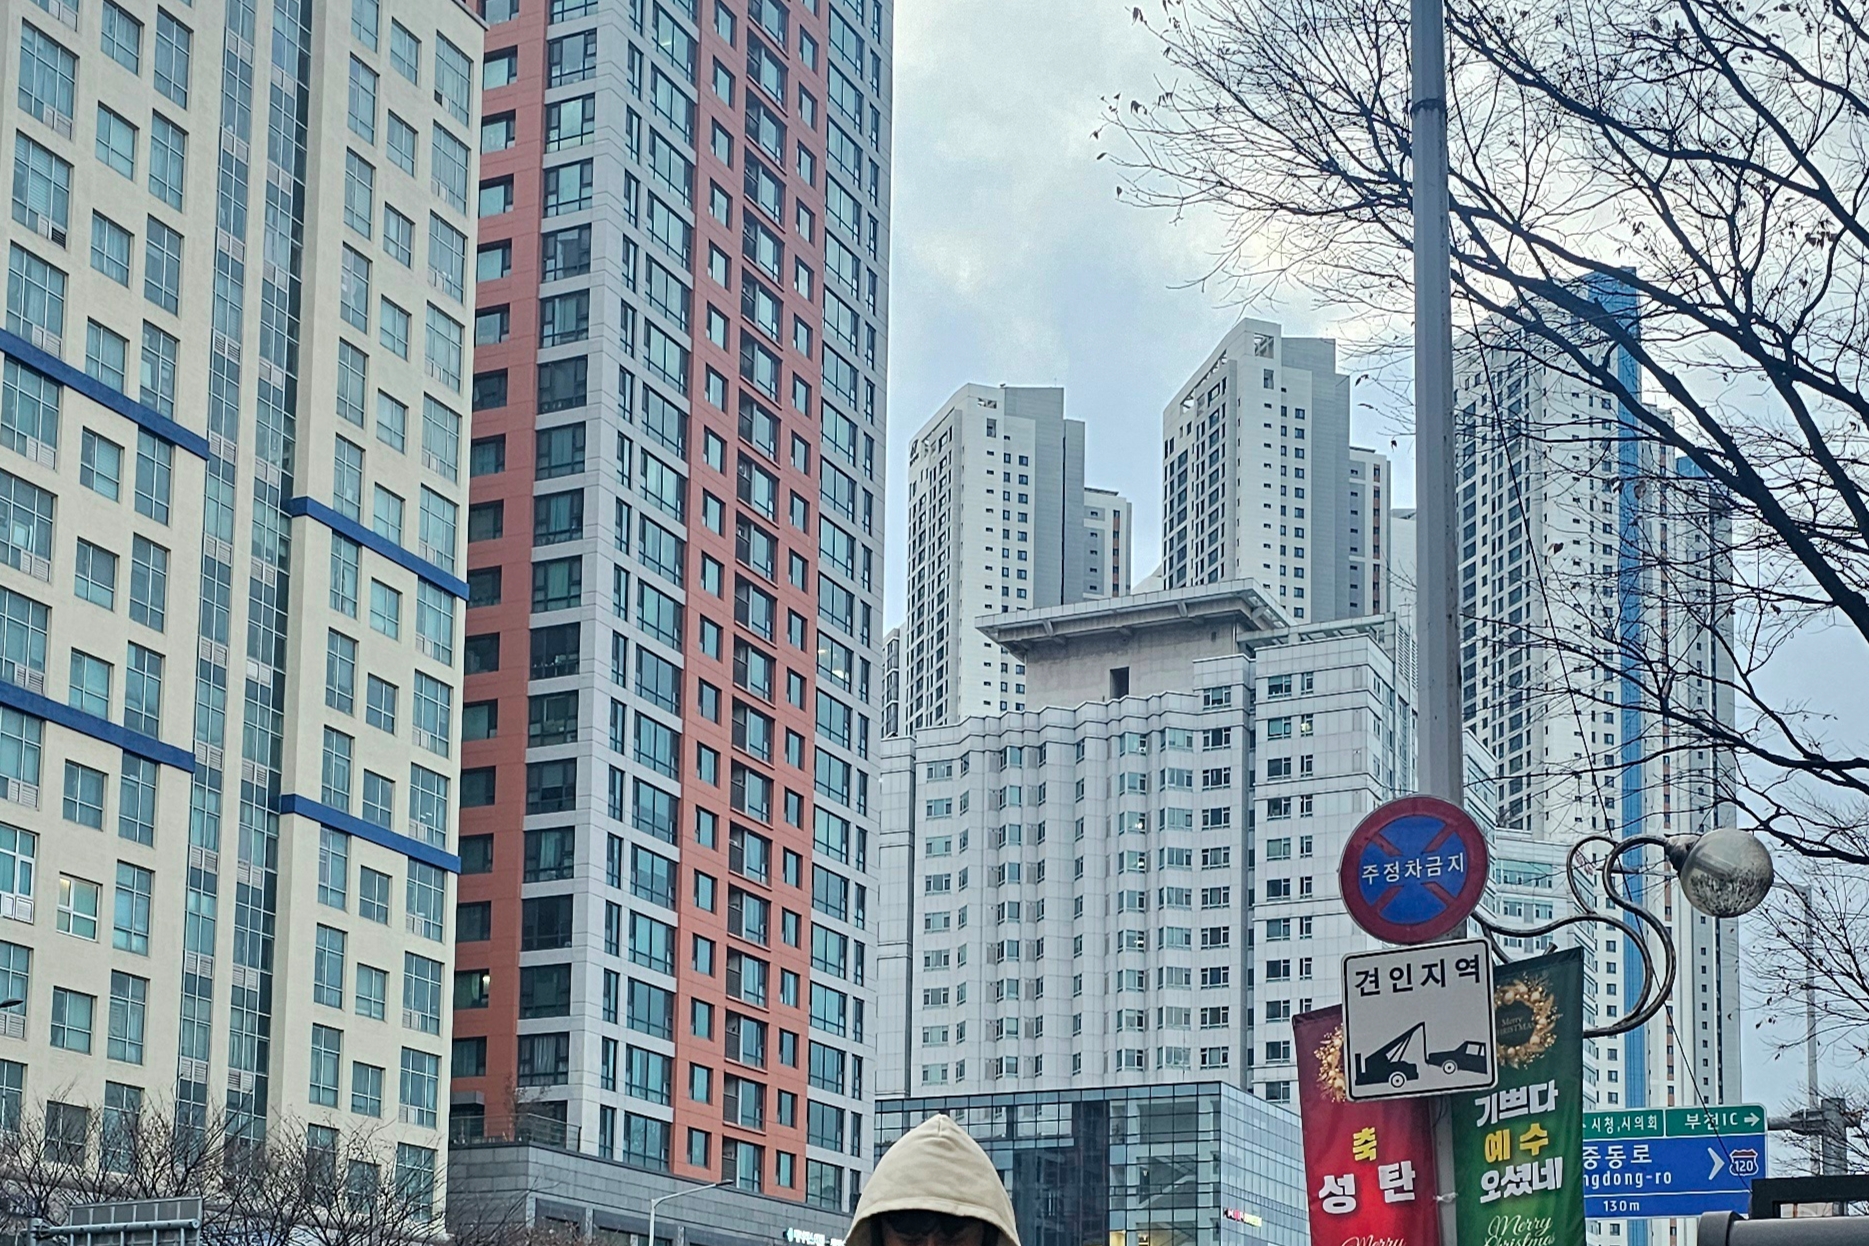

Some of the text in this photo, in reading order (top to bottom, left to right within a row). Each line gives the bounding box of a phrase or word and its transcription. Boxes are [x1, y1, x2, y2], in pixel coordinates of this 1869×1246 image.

[1362, 852, 1464, 885] 주정차금지
[1355, 954, 1481, 997] 견인지역
[1475, 1080, 1558, 1127] 기쁘다
[1353, 1127, 1377, 1161] 축
[1583, 1144, 1653, 1170] 중동로
[1480, 1157, 1562, 1203] 오셨네
[1733, 1161, 1754, 1173] 120
[1603, 1200, 1641, 1212] 130m
[1487, 1214, 1553, 1238] Merry
